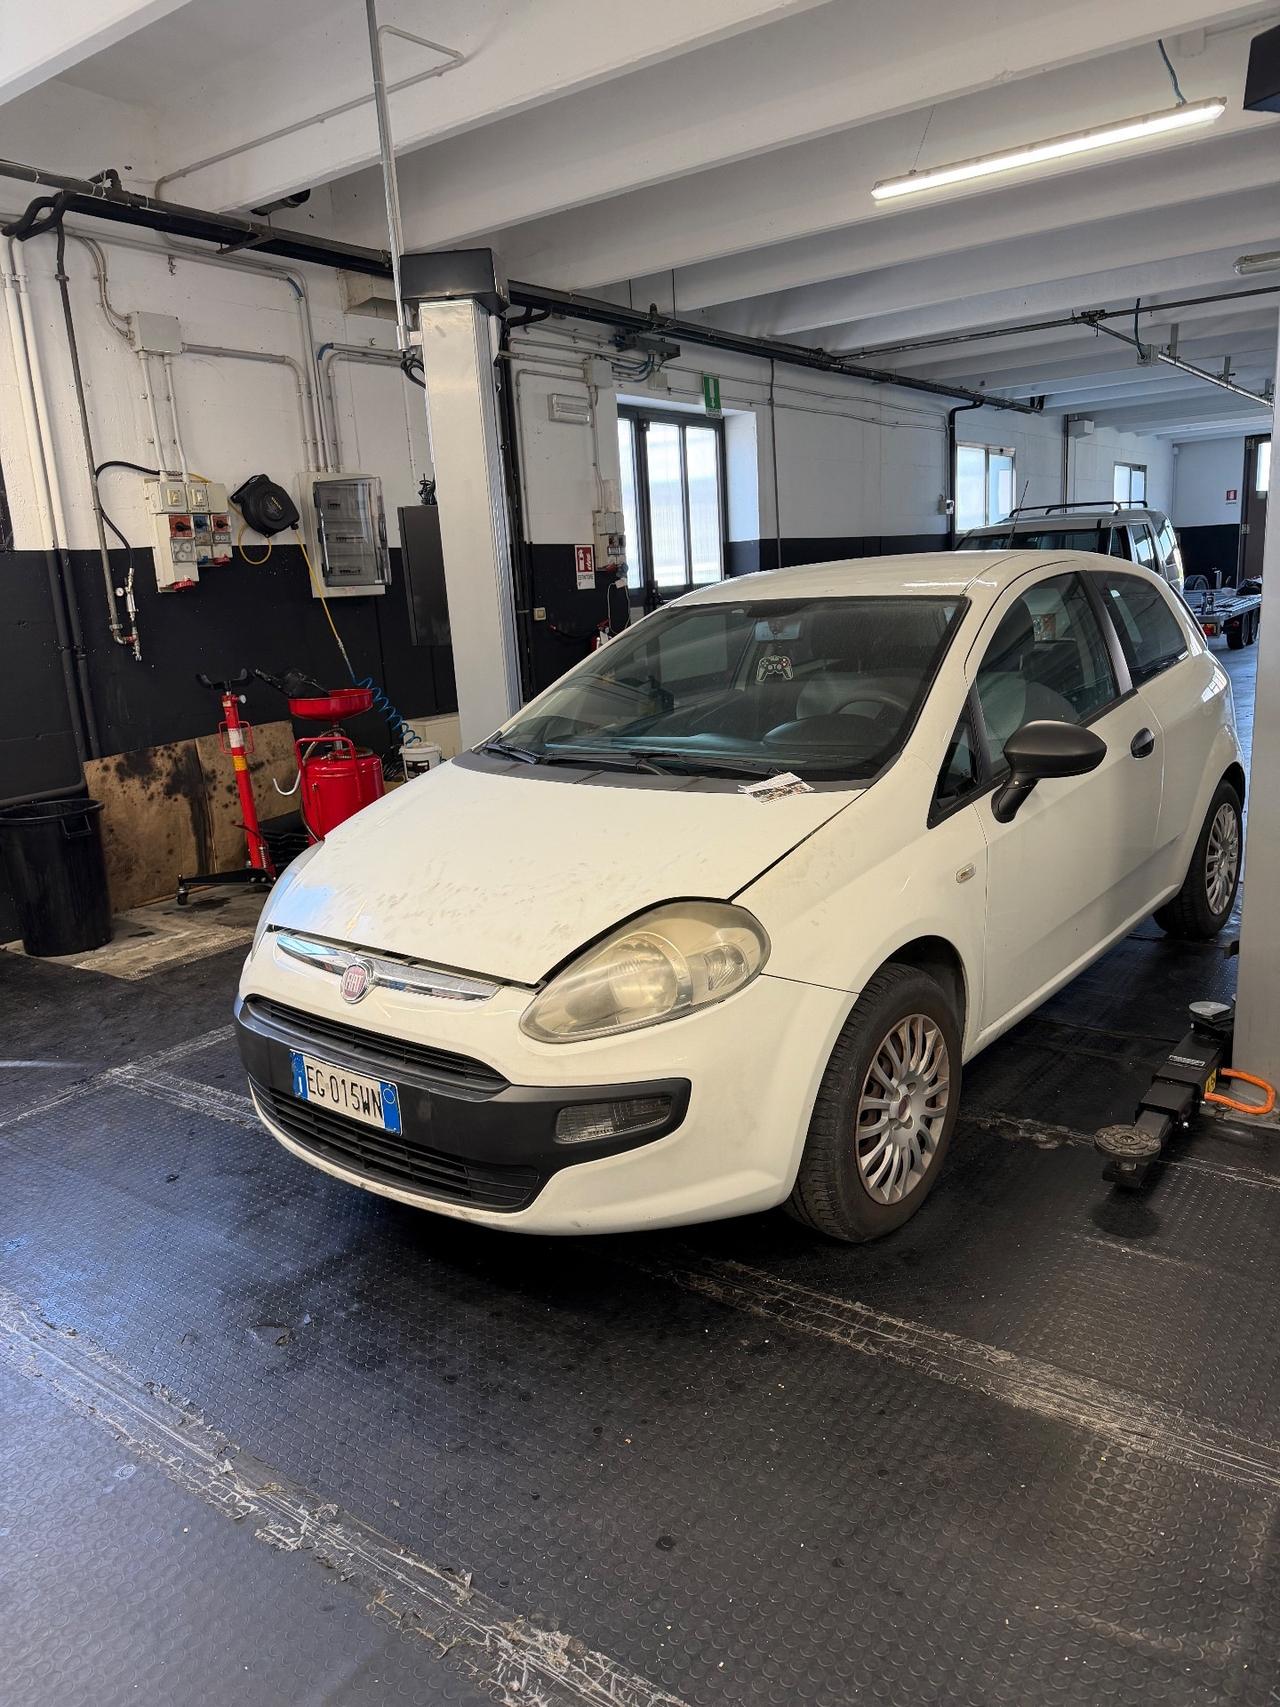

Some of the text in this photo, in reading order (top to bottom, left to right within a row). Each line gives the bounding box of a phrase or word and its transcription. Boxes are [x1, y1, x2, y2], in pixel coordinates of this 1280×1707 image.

[344, 971, 365, 993] FIAT
[306, 1065, 383, 1120] EG 015WN
